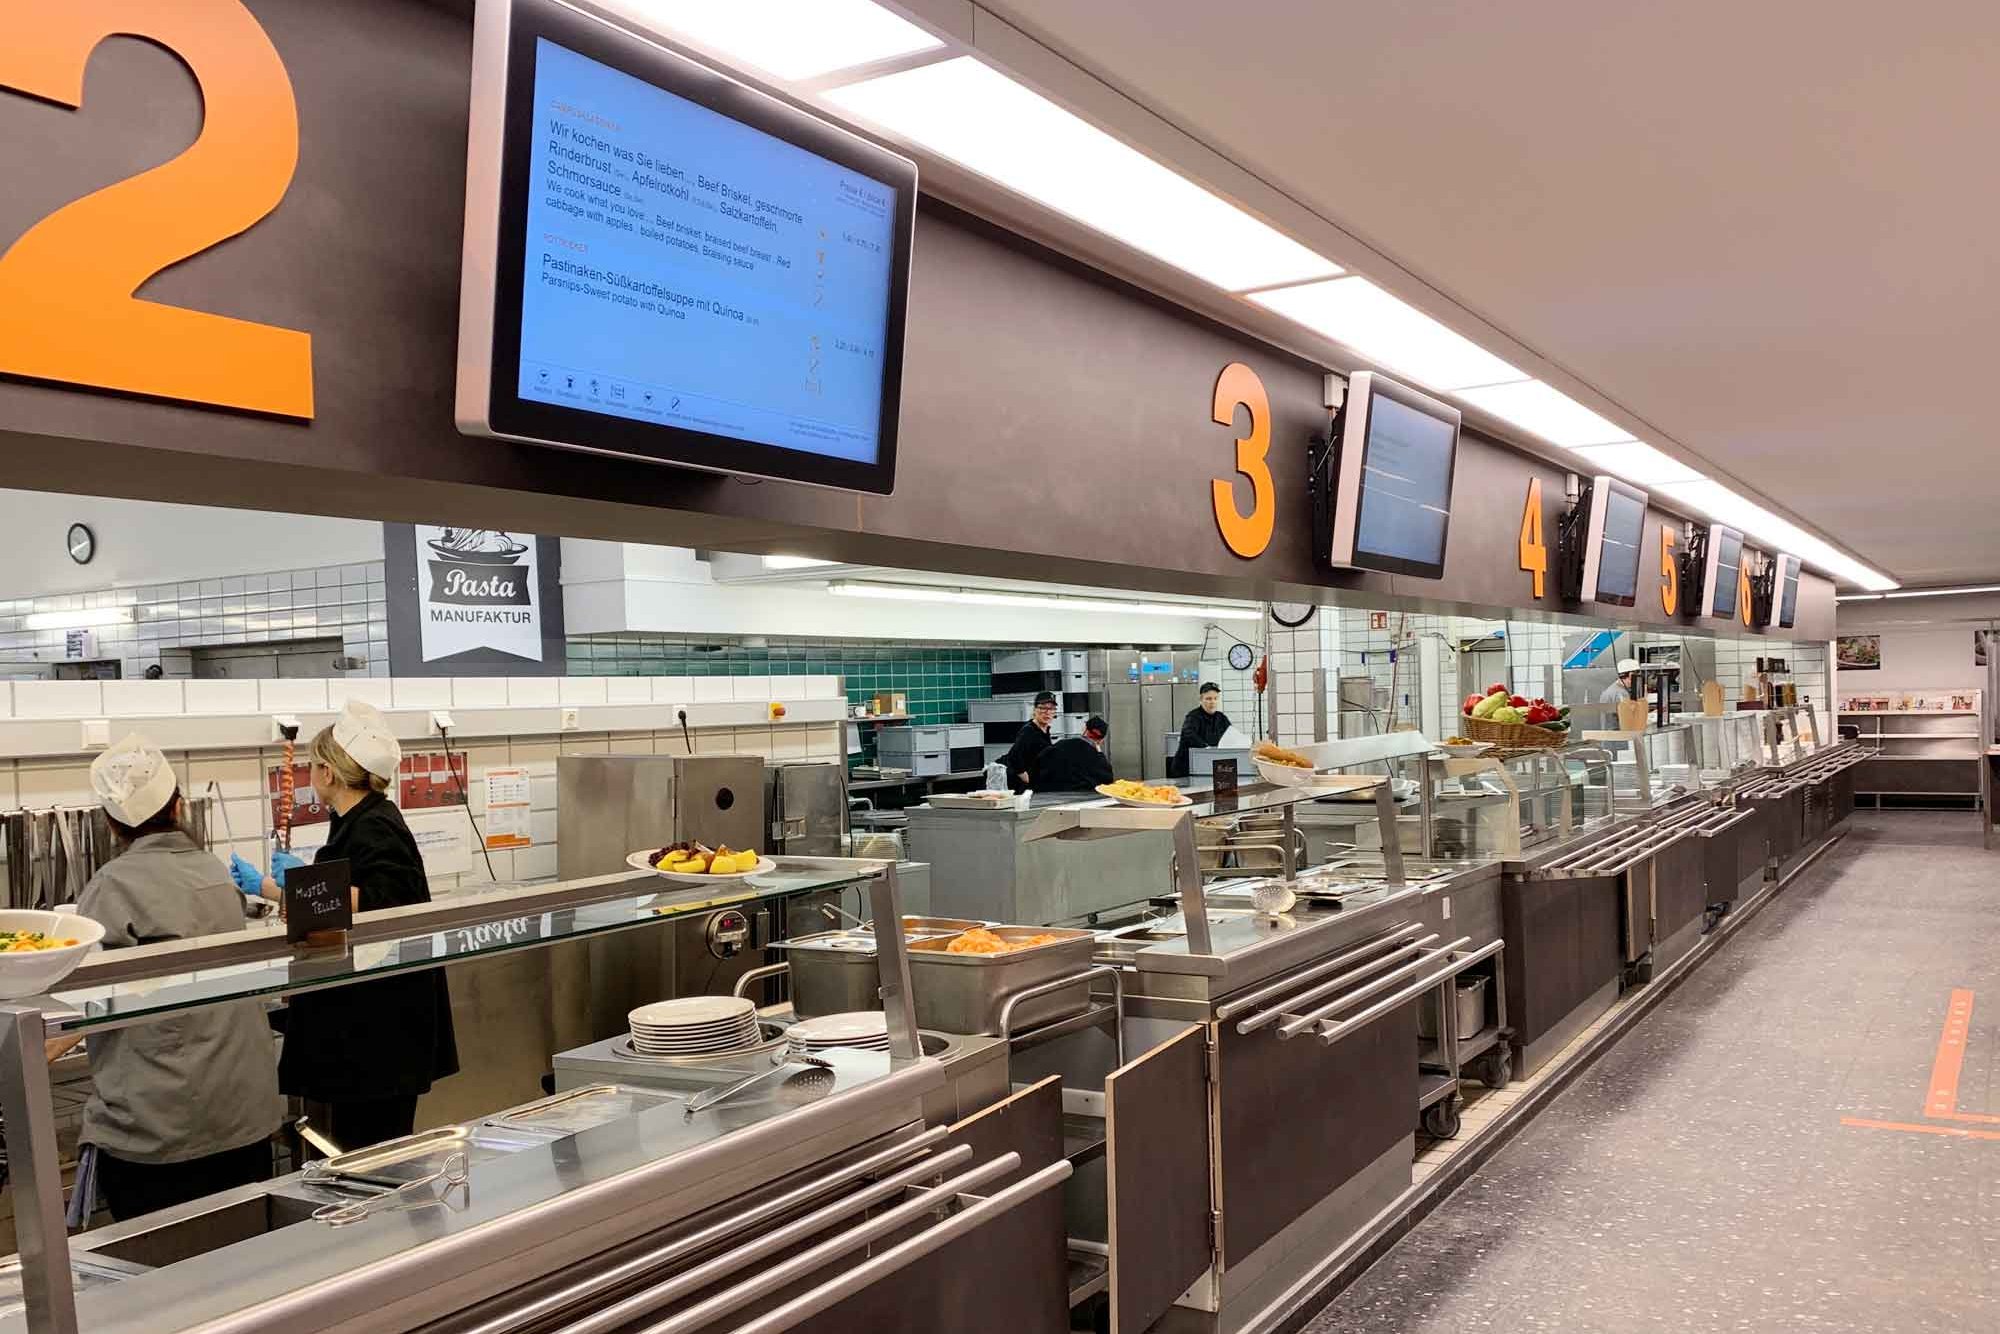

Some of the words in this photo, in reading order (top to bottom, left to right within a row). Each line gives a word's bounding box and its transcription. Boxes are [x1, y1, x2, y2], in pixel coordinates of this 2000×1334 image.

[547, 160, 622, 196] Schmorsauce
[549, 139, 612, 174] Rinderbrust
[631, 170, 690, 201] Apfelrotkohl
[550, 119, 569, 137] Wir
[571, 129, 610, 153] kochen
[613, 146, 634, 162] was
[637, 152, 653, 169] Sie
[697, 174, 720, 193] Beef
[0, 0, 314, 423] 2
[545, 197, 585, 217] cabbage
[546, 179, 562, 193] We
[563, 186, 586, 201] cook
[543, 253, 695, 308] Pastinaken-Süßkartoffelsuppe
[696, 298, 711, 312] mit
[712, 301, 745, 322] Quinoa
[1212, 362, 1276, 560] 3
[1519, 476, 1547, 599] 4
[1660, 523, 1678, 617] 5
[443, 568, 516, 598] Pasta
[1739, 554, 1752, 628] 6
[430, 608, 532, 624] MANUFAKTUR
[295, 881, 328, 900] MUSTER
